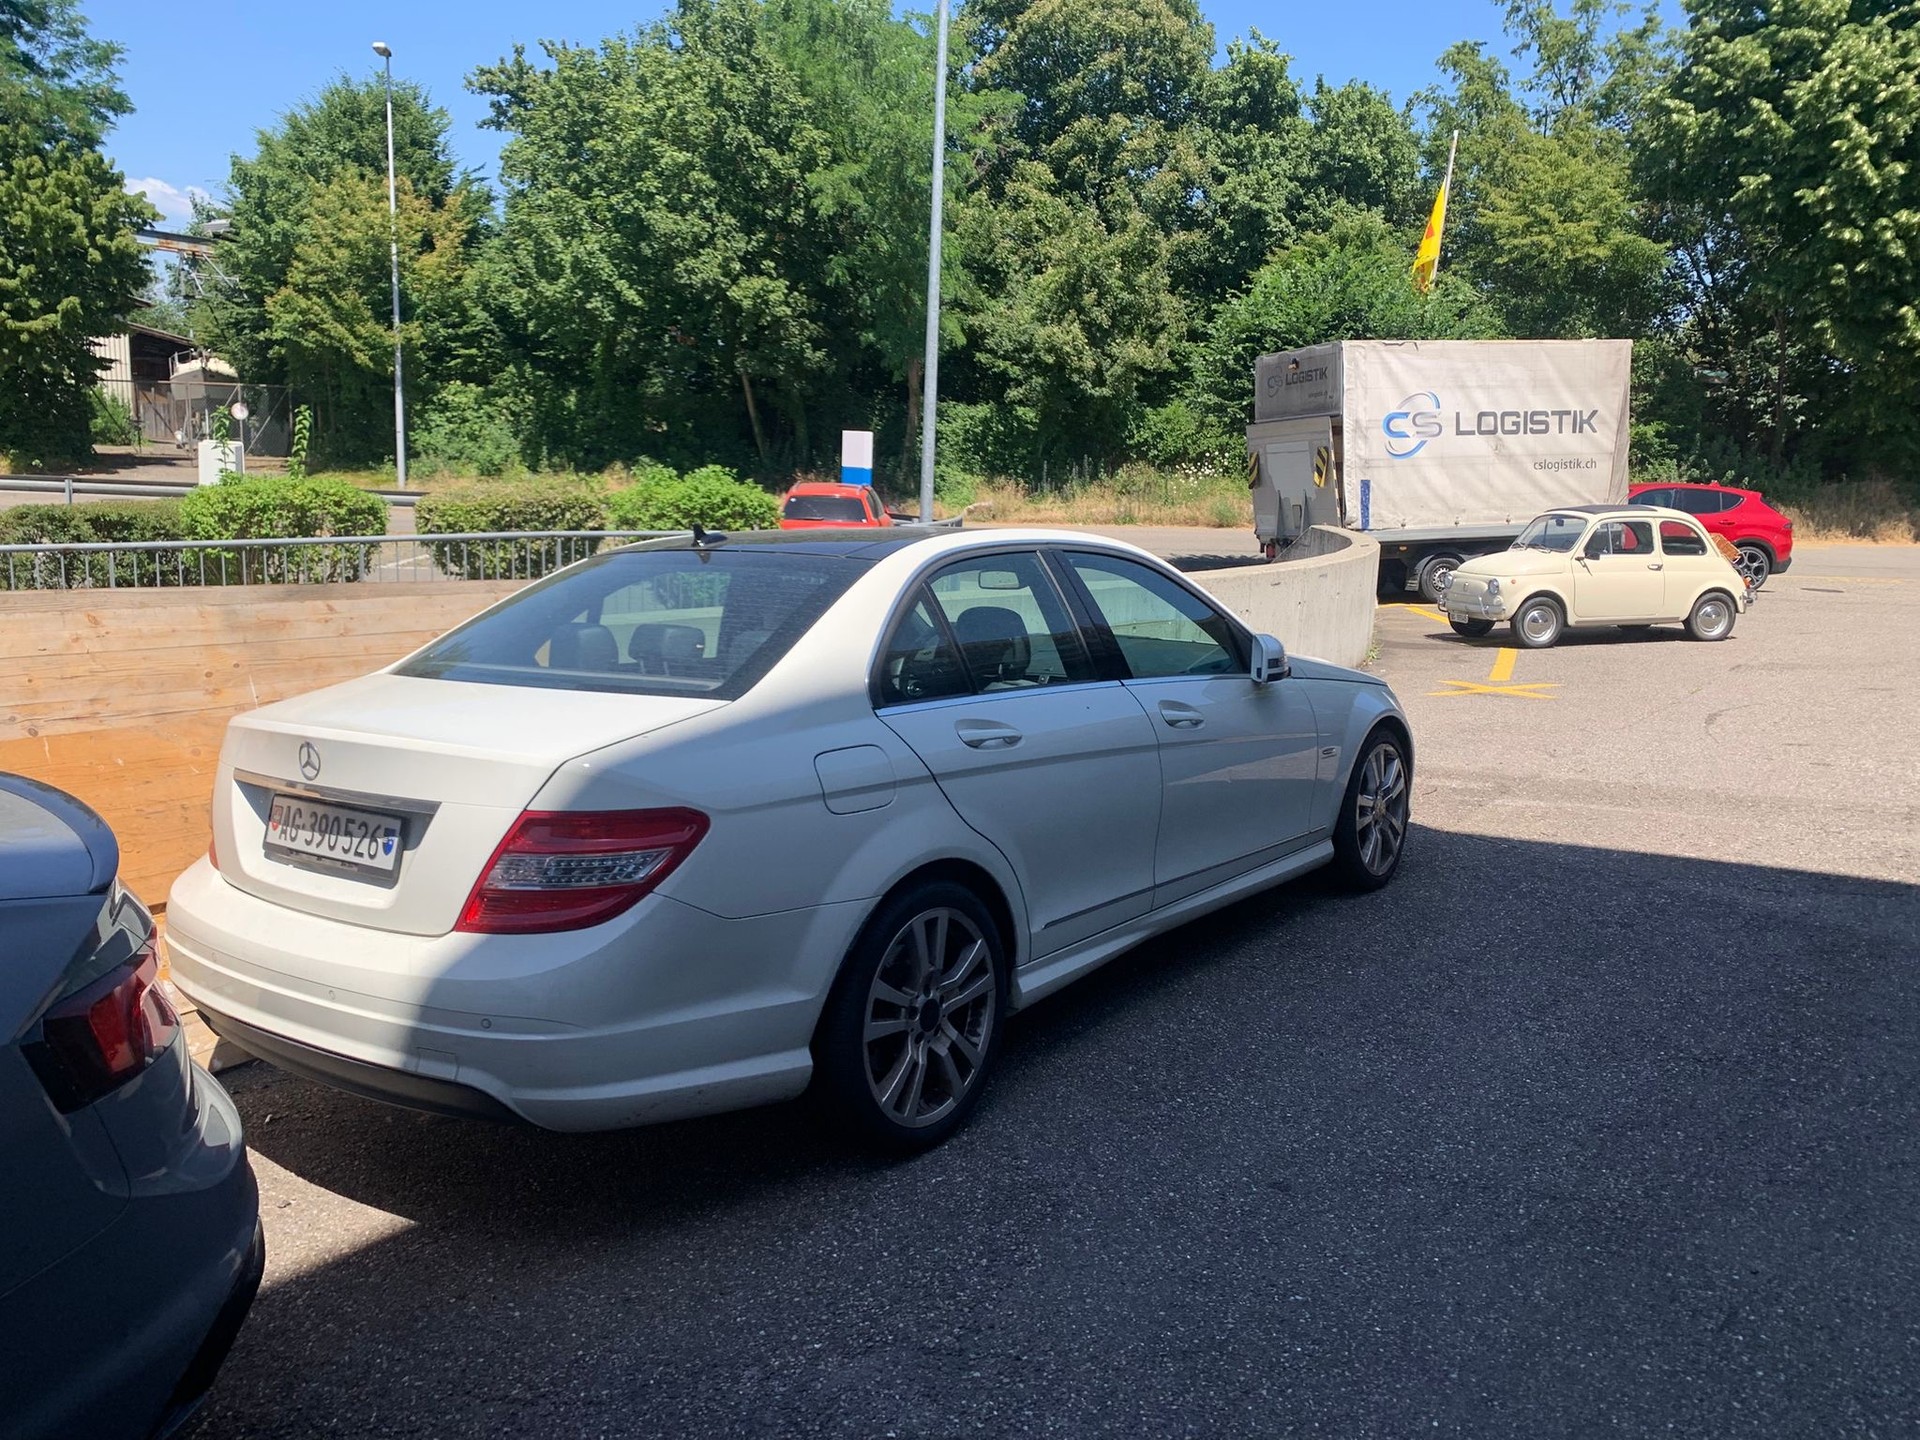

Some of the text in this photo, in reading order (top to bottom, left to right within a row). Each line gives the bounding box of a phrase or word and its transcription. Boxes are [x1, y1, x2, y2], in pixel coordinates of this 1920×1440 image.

[1285, 366, 1328, 385] LOGISTIK
[1382, 410, 1598, 438] CS LOGISTIK
[1533, 458, 1597, 472] cslogistik.ch
